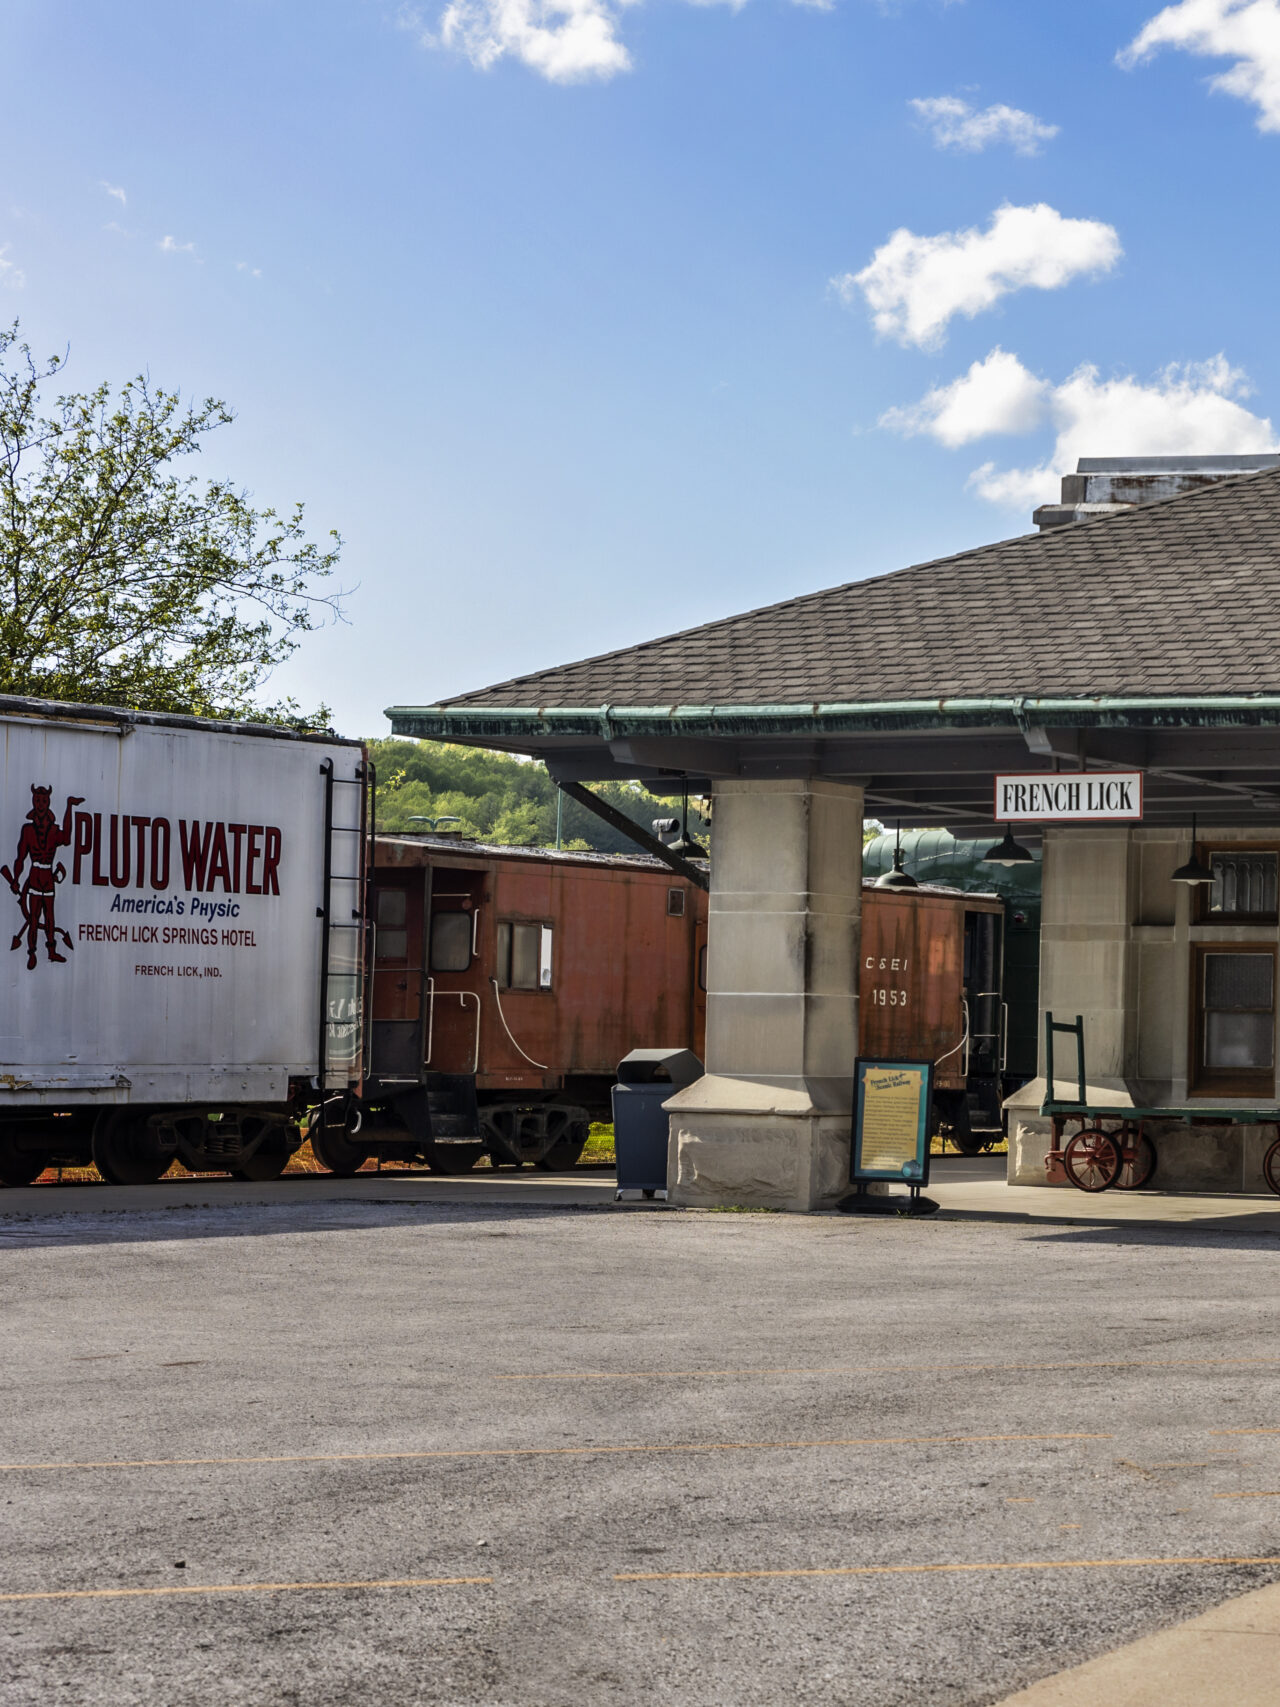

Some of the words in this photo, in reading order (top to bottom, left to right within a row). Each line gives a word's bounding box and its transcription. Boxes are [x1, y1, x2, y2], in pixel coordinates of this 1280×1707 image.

[1003, 783, 1081, 812] FRENCH
[1087, 782, 1132, 811] LICK
[72, 811, 171, 891] PLUTO
[179, 819, 282, 896] WATER
[110, 894, 185, 916] America's
[190, 897, 240, 923] Physic
[78, 924, 128, 943] FRENCH
[132, 926, 159, 944] LICK
[162, 927, 218, 946] SPRINGS
[221, 930, 257, 947] HOTEL
[135, 965, 174, 977] FRENCH
[177, 967, 202, 979] LICK,
[204, 967, 222, 978] IND.
[873, 989, 907, 1006] 1953
